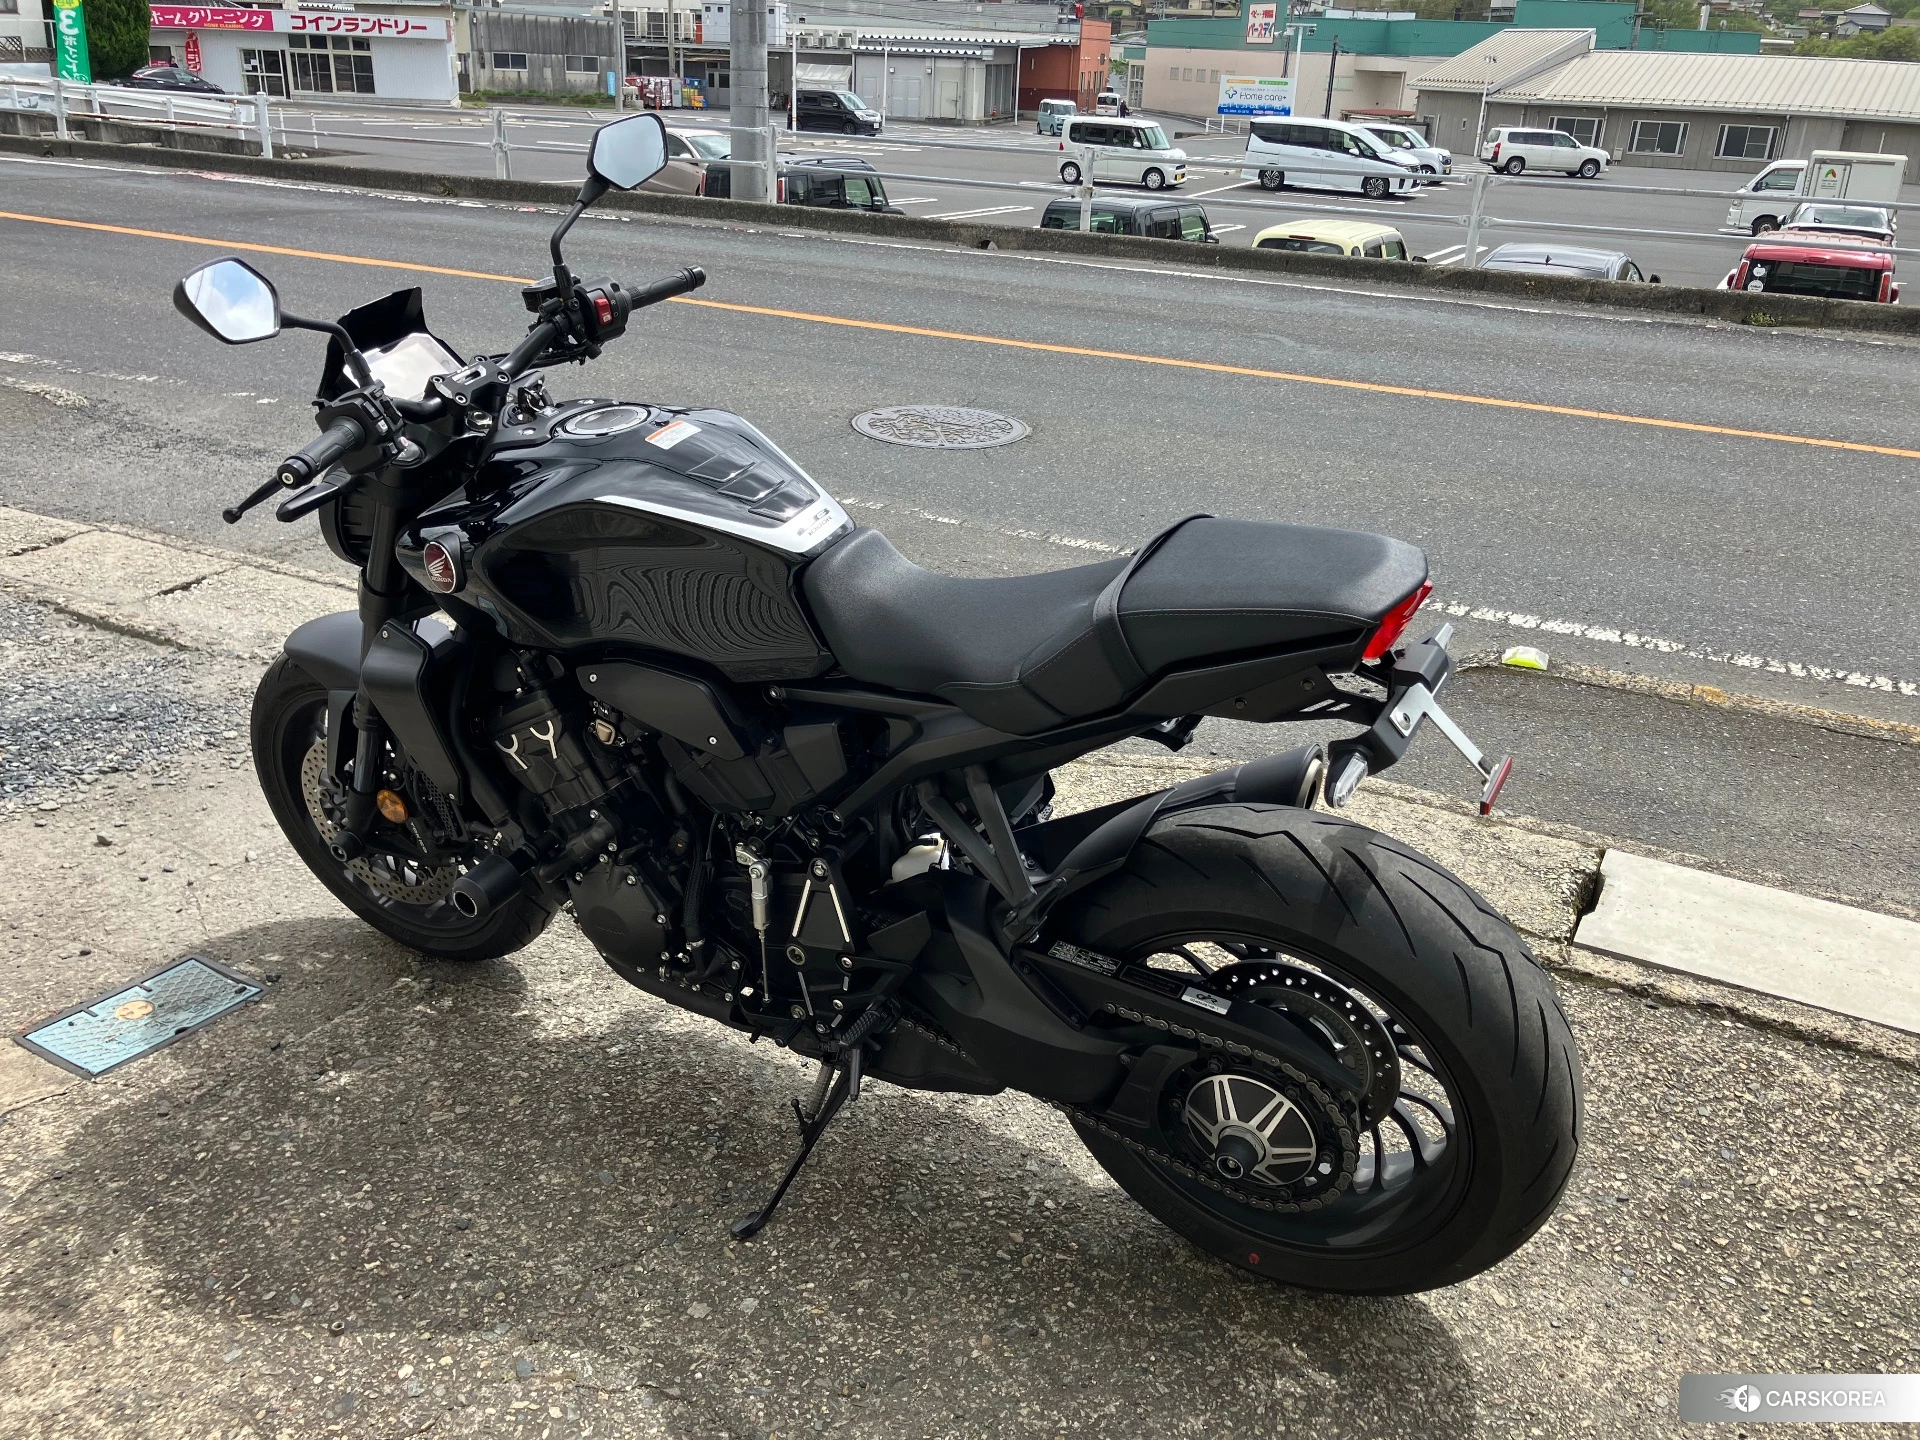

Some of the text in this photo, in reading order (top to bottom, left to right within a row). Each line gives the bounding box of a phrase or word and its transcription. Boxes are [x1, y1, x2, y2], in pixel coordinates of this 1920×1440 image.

[151, 9, 265, 27] ホームクリーニング
[290, 14, 427, 35] コインランドリー
[1239, 92, 1263, 101] Home
